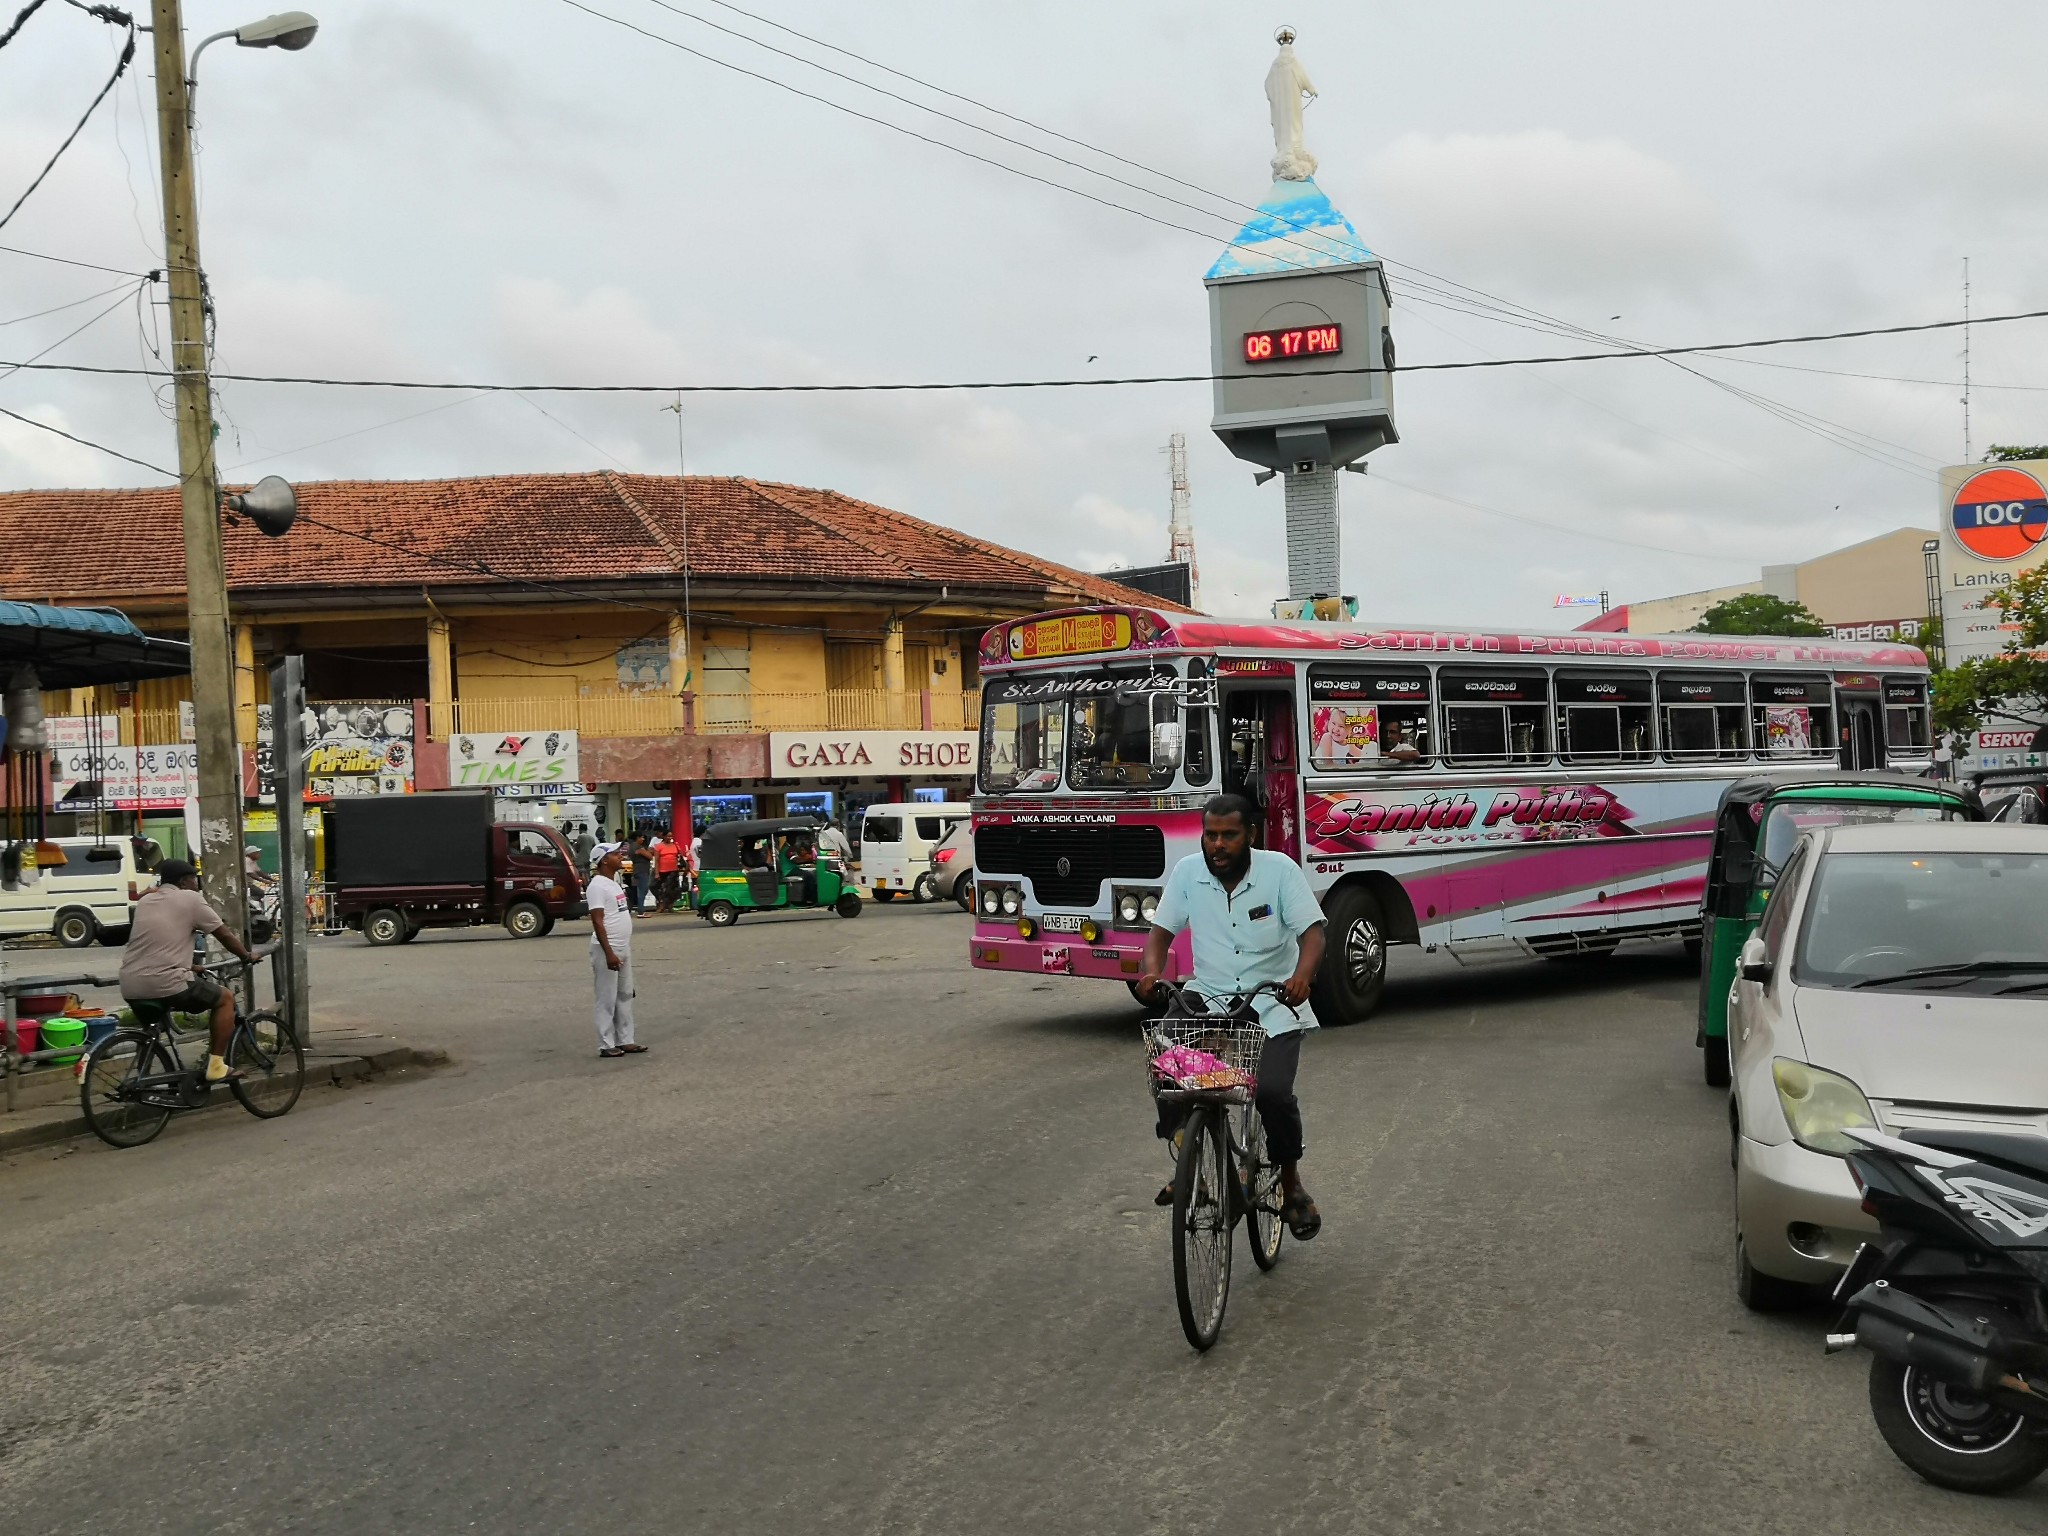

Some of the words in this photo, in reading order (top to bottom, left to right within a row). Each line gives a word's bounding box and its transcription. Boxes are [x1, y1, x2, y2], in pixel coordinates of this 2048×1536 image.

[1247, 335, 1271, 357] 06
[1281, 331, 1302, 354] 17
[1307, 328, 1337, 351] PM
[1976, 502, 2025, 525] IOC
[1954, 570, 2011, 587] Lanka
[1063, 620, 1077, 649] 04
[1038, 643, 1061, 654] PUTTALAM
[1077, 640, 1101, 650] COLOMBO
[1339, 631, 1500, 651] Sanith
[1517, 634, 1646, 656] Putha
[1659, 640, 1780, 660] Power
[1794, 644, 1865, 664] Line
[1003, 684, 1031, 698] St.
[1033, 673, 1173, 694] Anthony's
[1314, 680, 1361, 690] කොළඹ
[1352, 726, 1363, 734] 04
[1980, 733, 2034, 748] SERVO
[787, 741, 872, 767] GAYA
[899, 741, 972, 767] SHOE
[530, 783, 583, 795] TIMES
[1012, 815, 1040, 823] LANKA
[1042, 815, 1072, 823] ASHOK
[1074, 815, 1115, 823] LEYLAND
[1316, 793, 1477, 836] Sanith
[1481, 790, 1610, 826] Putha
[1404, 829, 1516, 847] Power
